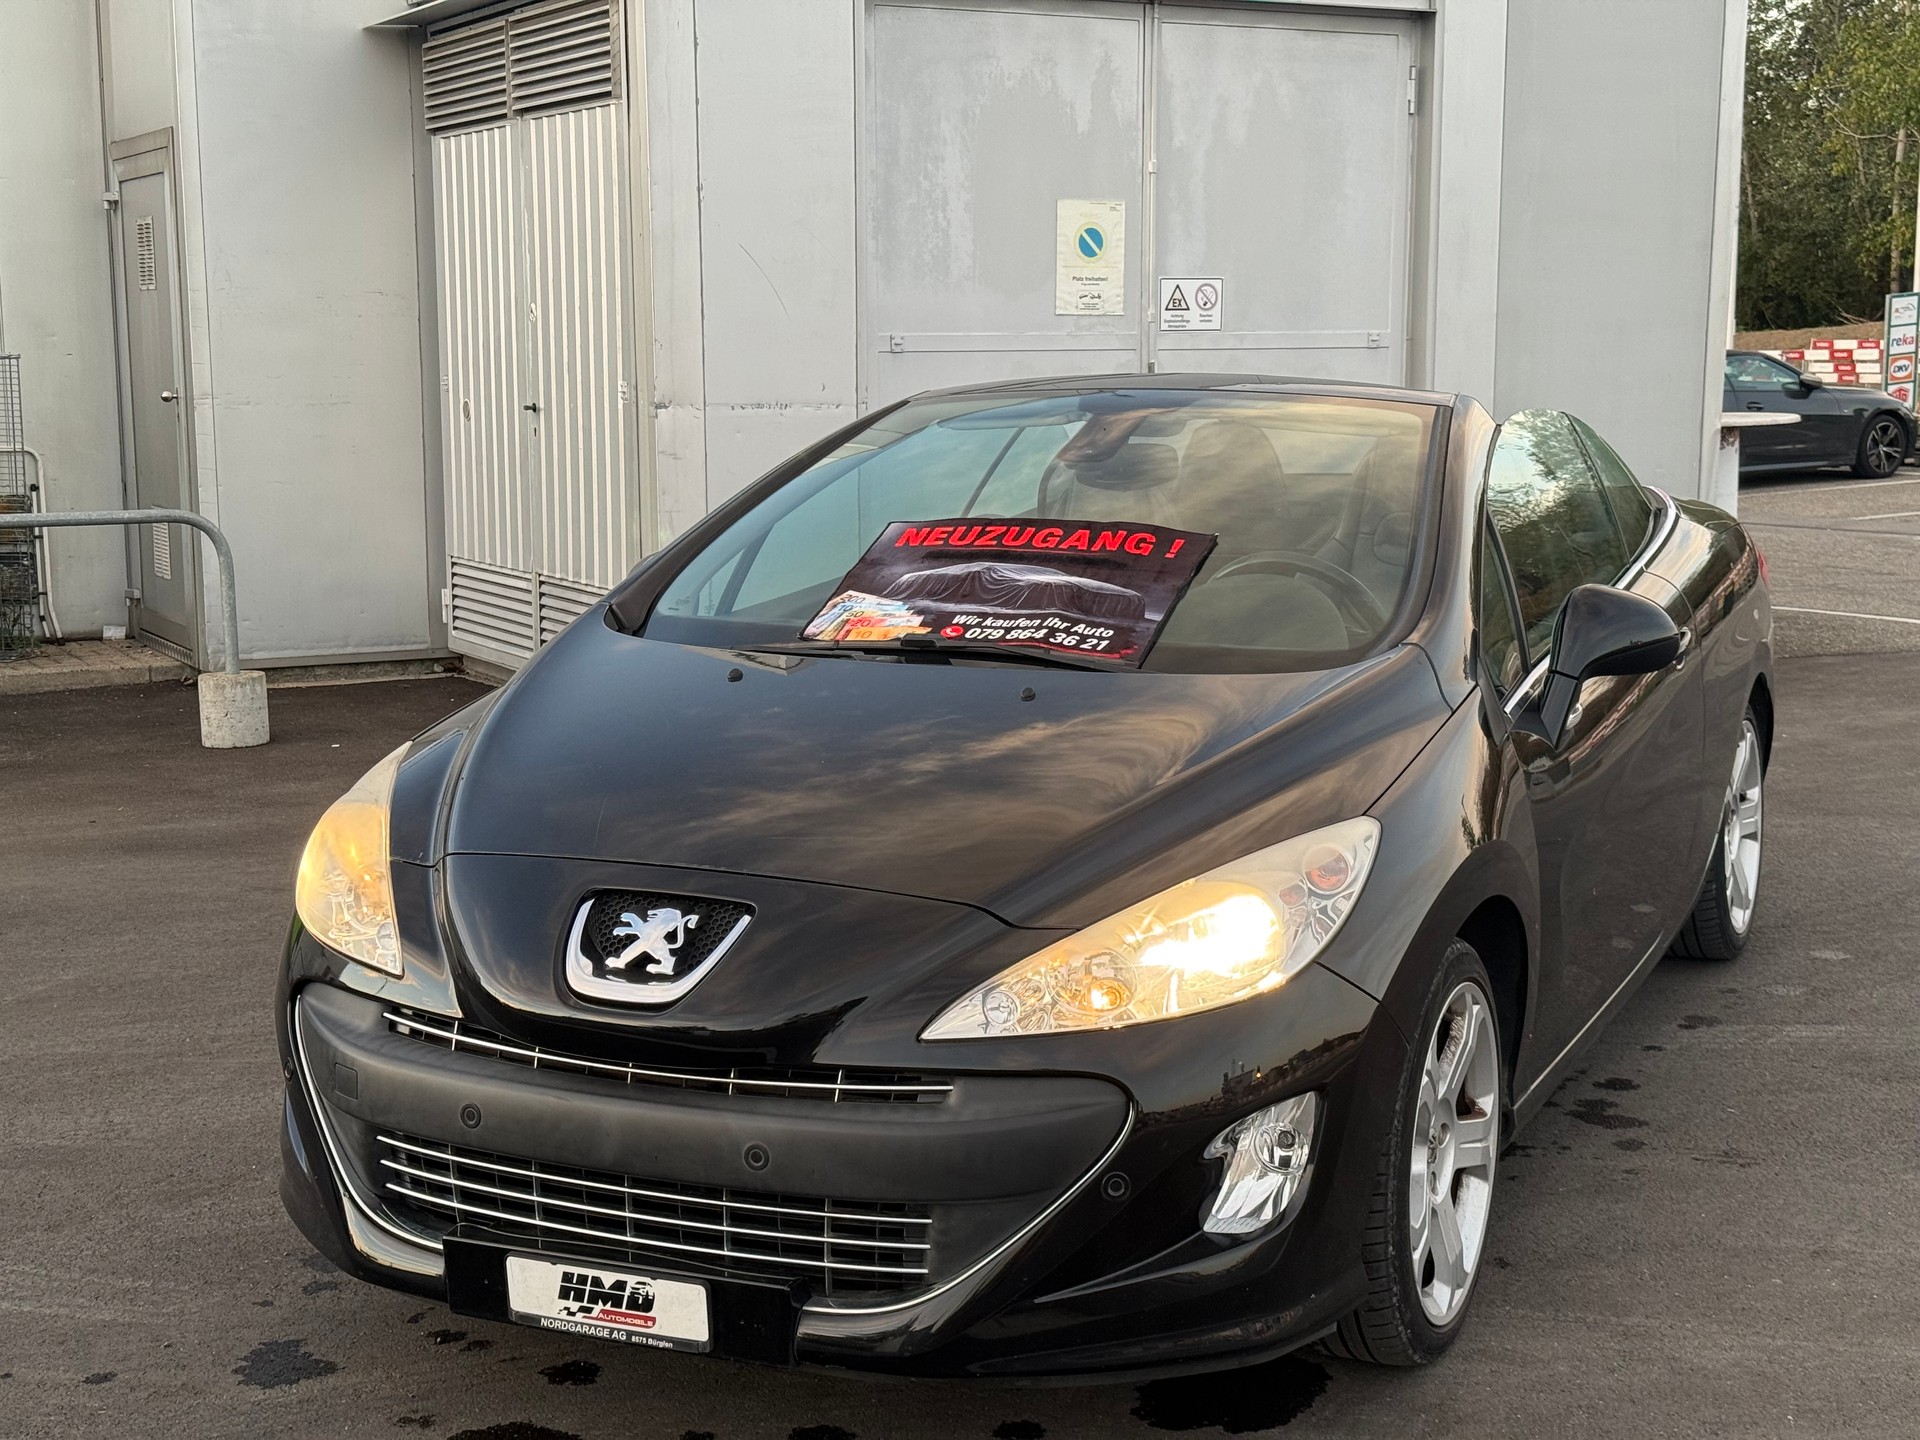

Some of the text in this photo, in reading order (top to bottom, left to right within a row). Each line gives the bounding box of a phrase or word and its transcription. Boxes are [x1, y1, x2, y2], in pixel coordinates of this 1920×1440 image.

[1172, 298, 1183, 307] EX
[1890, 334, 1914, 348] reka
[1893, 364, 1910, 374] DKV
[895, 525, 1156, 556] NEUZUGANG
[850, 619, 871, 627] 20
[951, 615, 1115, 638] Wir kaufen Ihr Auto
[854, 630, 872, 638] 10
[964, 628, 1110, 651] 079 864 36 21
[597, 1313, 654, 1327] AUTOMOBILE
[540, 1317, 610, 1338] NORDGARAGE
[612, 1332, 627, 1341] AG
